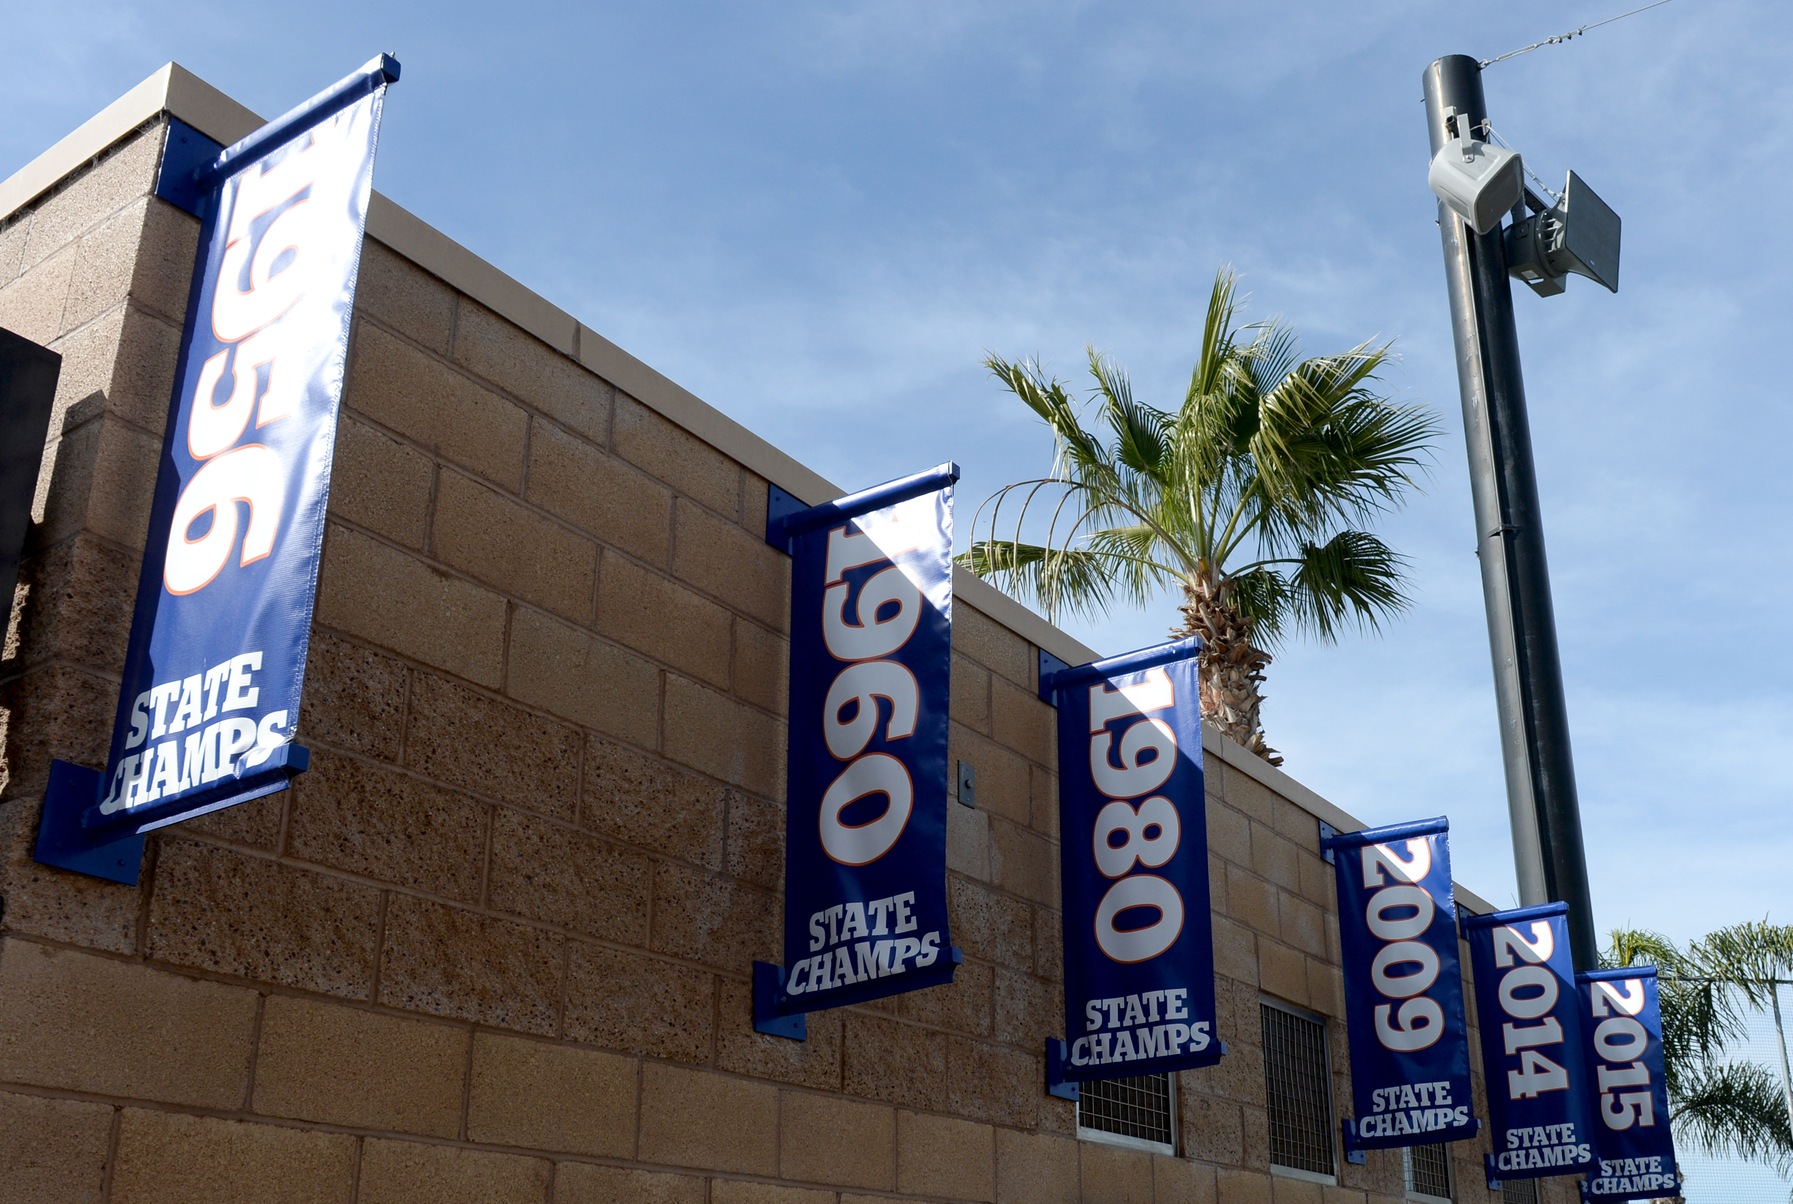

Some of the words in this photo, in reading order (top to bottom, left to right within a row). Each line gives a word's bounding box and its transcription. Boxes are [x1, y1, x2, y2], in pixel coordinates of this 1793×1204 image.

[126, 651, 264, 751] STATE
[819, 503, 923, 869] 1960
[100, 709, 289, 816] CHAMPS
[1089, 667, 1186, 965] 1980
[809, 891, 919, 953] STATE
[1361, 836, 1446, 1053] 2009
[787, 932, 941, 997] CHAMPS
[1085, 988, 1189, 1032] STATE
[1492, 920, 1570, 1100] 2014
[1071, 1021, 1211, 1068] CHAMPS
[1591, 978, 1656, 1132] 2015
[1359, 1106, 1469, 1139] CHAMPS
[1372, 1081, 1452, 1113] STATE
[1498, 1143, 1592, 1172] CHAMPS
[1506, 1123, 1577, 1150] STATE
[1600, 1156, 1662, 1178] STATE
[1591, 1173, 1676, 1196] CHAMPS
